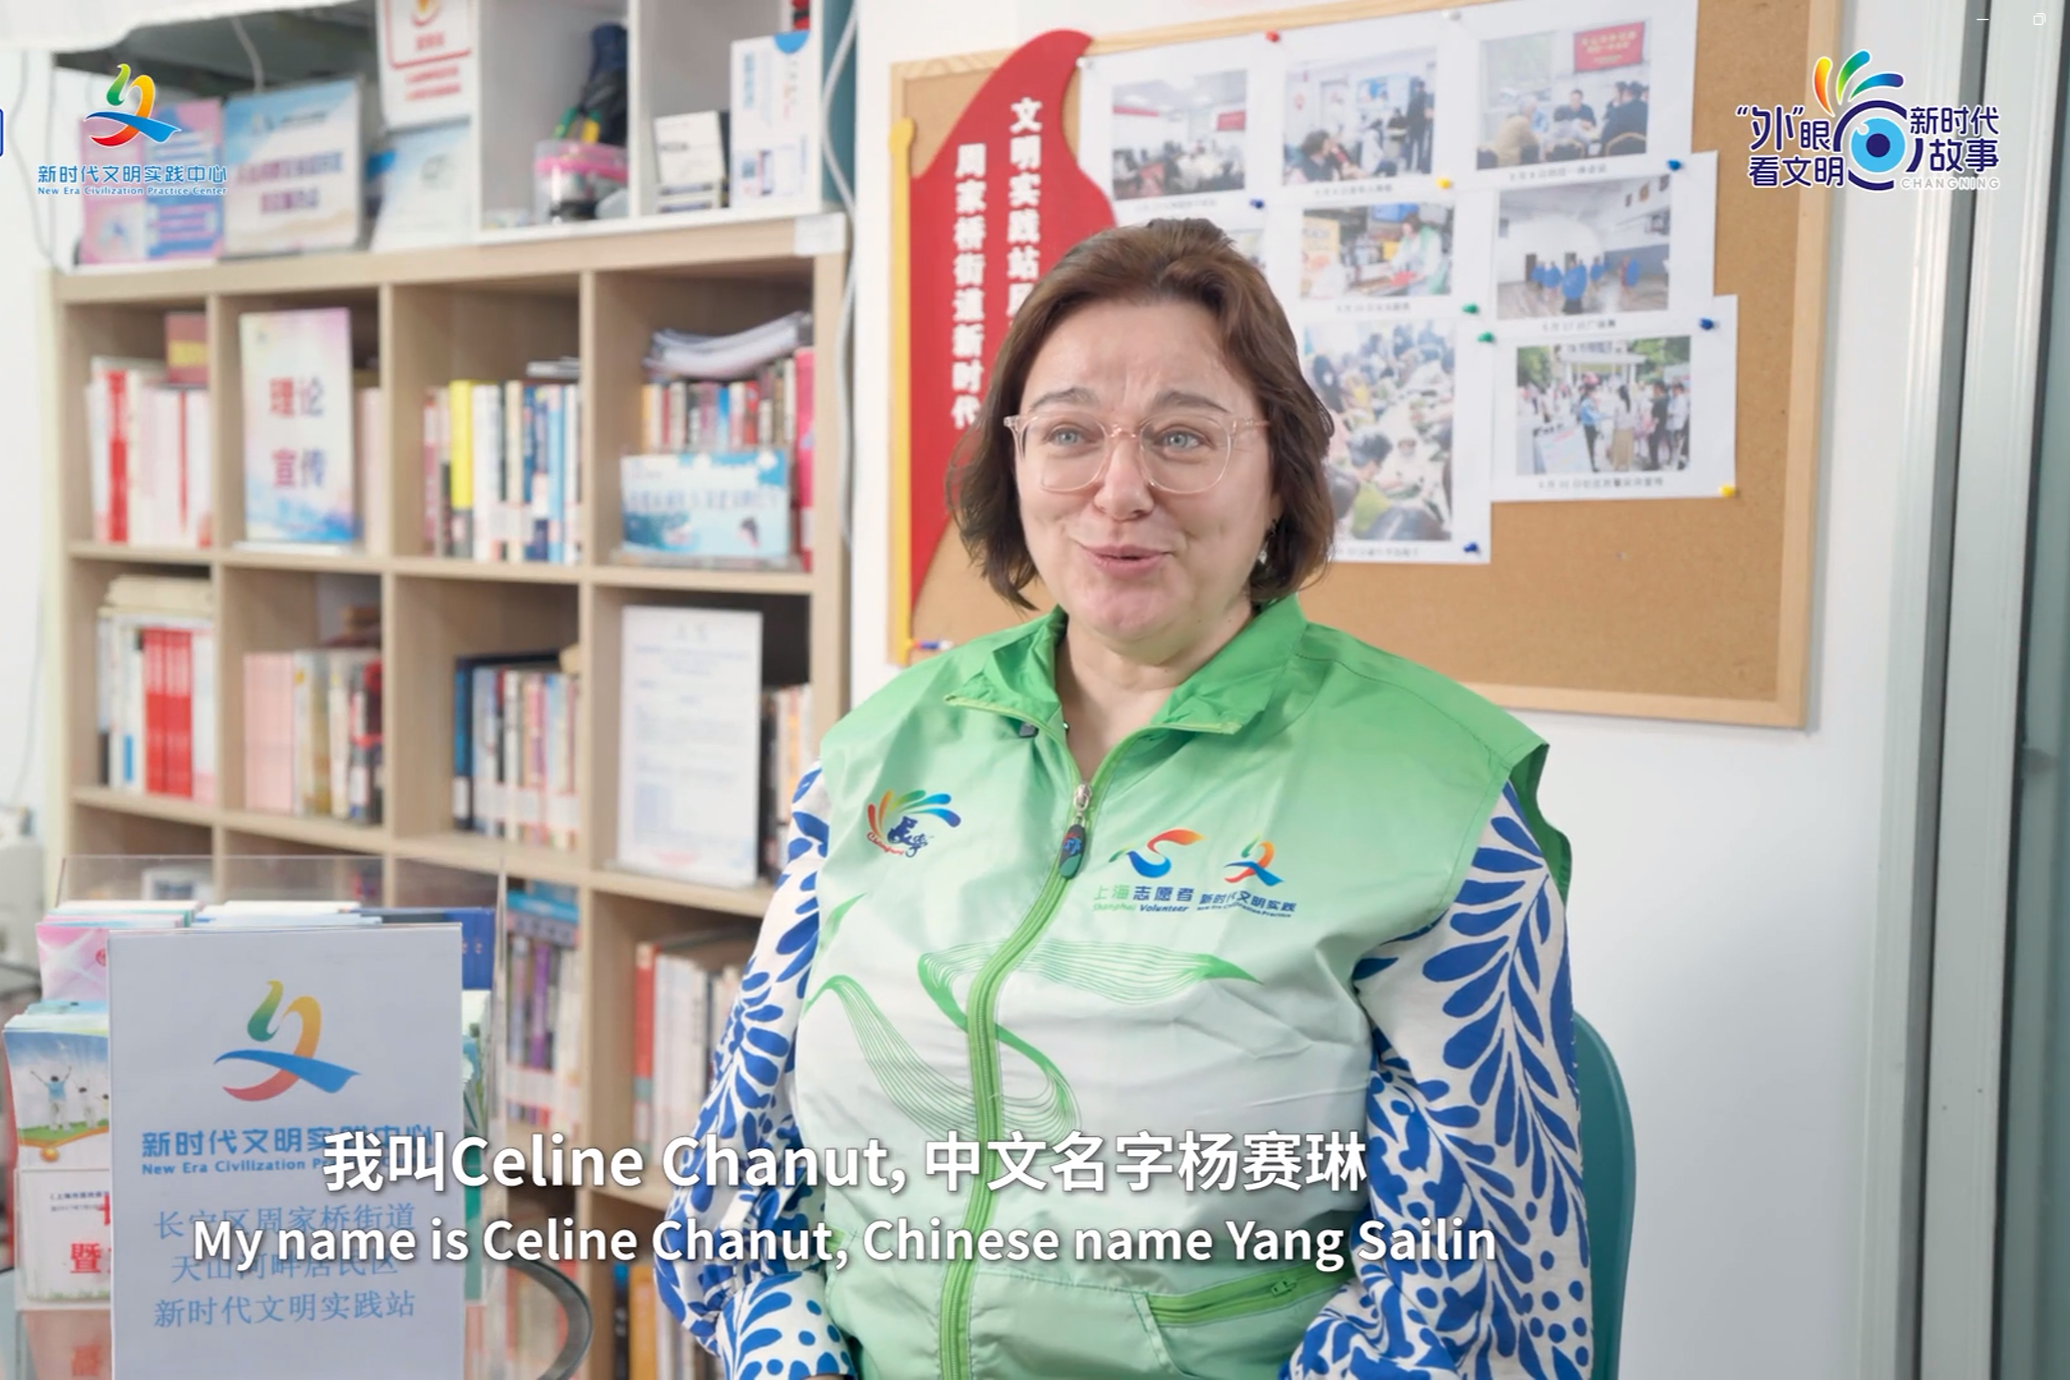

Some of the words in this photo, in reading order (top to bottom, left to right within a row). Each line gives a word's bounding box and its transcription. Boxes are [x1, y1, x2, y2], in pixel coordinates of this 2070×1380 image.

[952, 143, 986, 430] 周家桥街道新时代
[269, 377, 324, 418] 理论
[272, 449, 326, 488] 宣传
[1092, 902, 1137, 912] Shanghai
[1139, 903, 1190, 912] Volunteer
[1198, 890, 1298, 913] 新时代文明实践
[142, 1162, 176, 1175] New
[182, 1161, 208, 1174] Era
[214, 1158, 306, 1173] Civilization
[154, 1289, 416, 1328] 新时代文明实践站
